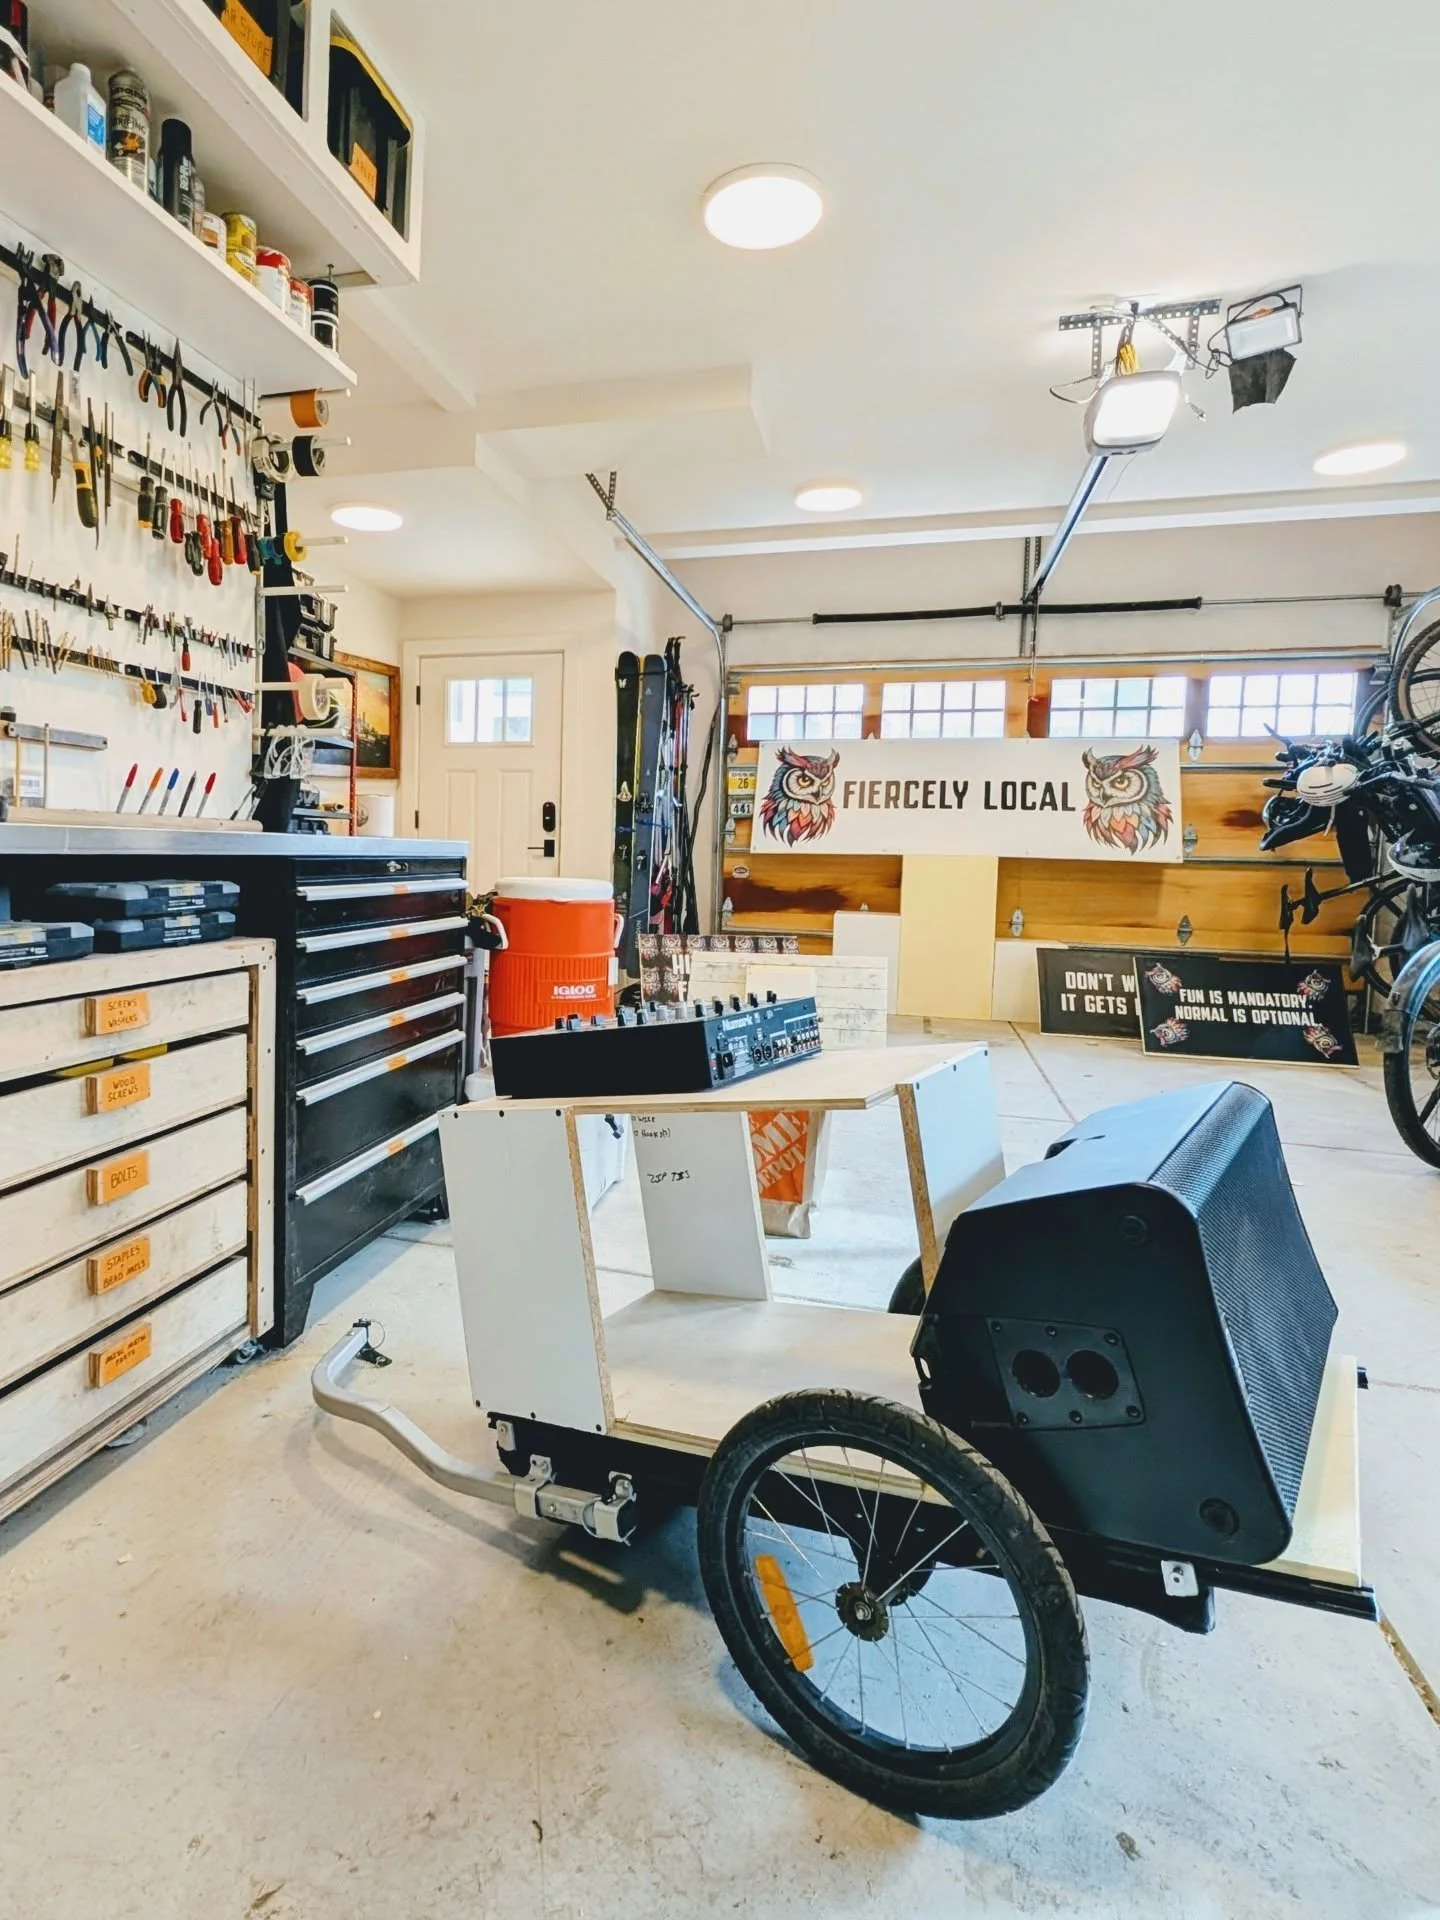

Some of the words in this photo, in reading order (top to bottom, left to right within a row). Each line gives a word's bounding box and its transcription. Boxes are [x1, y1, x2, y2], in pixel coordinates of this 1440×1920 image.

[737, 778, 749, 790] 26
[843, 780, 968, 810] FIERCELY
[984, 780, 1076, 812] LOCAL
[733, 803, 751, 815] 441
[553, 985, 595, 996] IGLOO
[1065, 971, 1114, 992] DON'T
[1061, 993, 1077, 1012] IT
[1084, 994, 1128, 1015] GETS
[1180, 988, 1204, 1004] FUN
[1210, 989, 1223, 1004] IS
[1228, 991, 1313, 1009] MANDATORY.
[722, 1014, 754, 1032] Numark
[1175, 1005, 1228, 1023] NORMAL
[1233, 1008, 1247, 1024] IS
[1252, 1009, 1323, 1027] OPTIONAL.
[112, 1076, 136, 1089] WOOD
[107, 1087, 139, 1102] SCREWS
[110, 1164, 139, 1189] BOLTS
[106, 1245, 141, 1270] STAPLES
